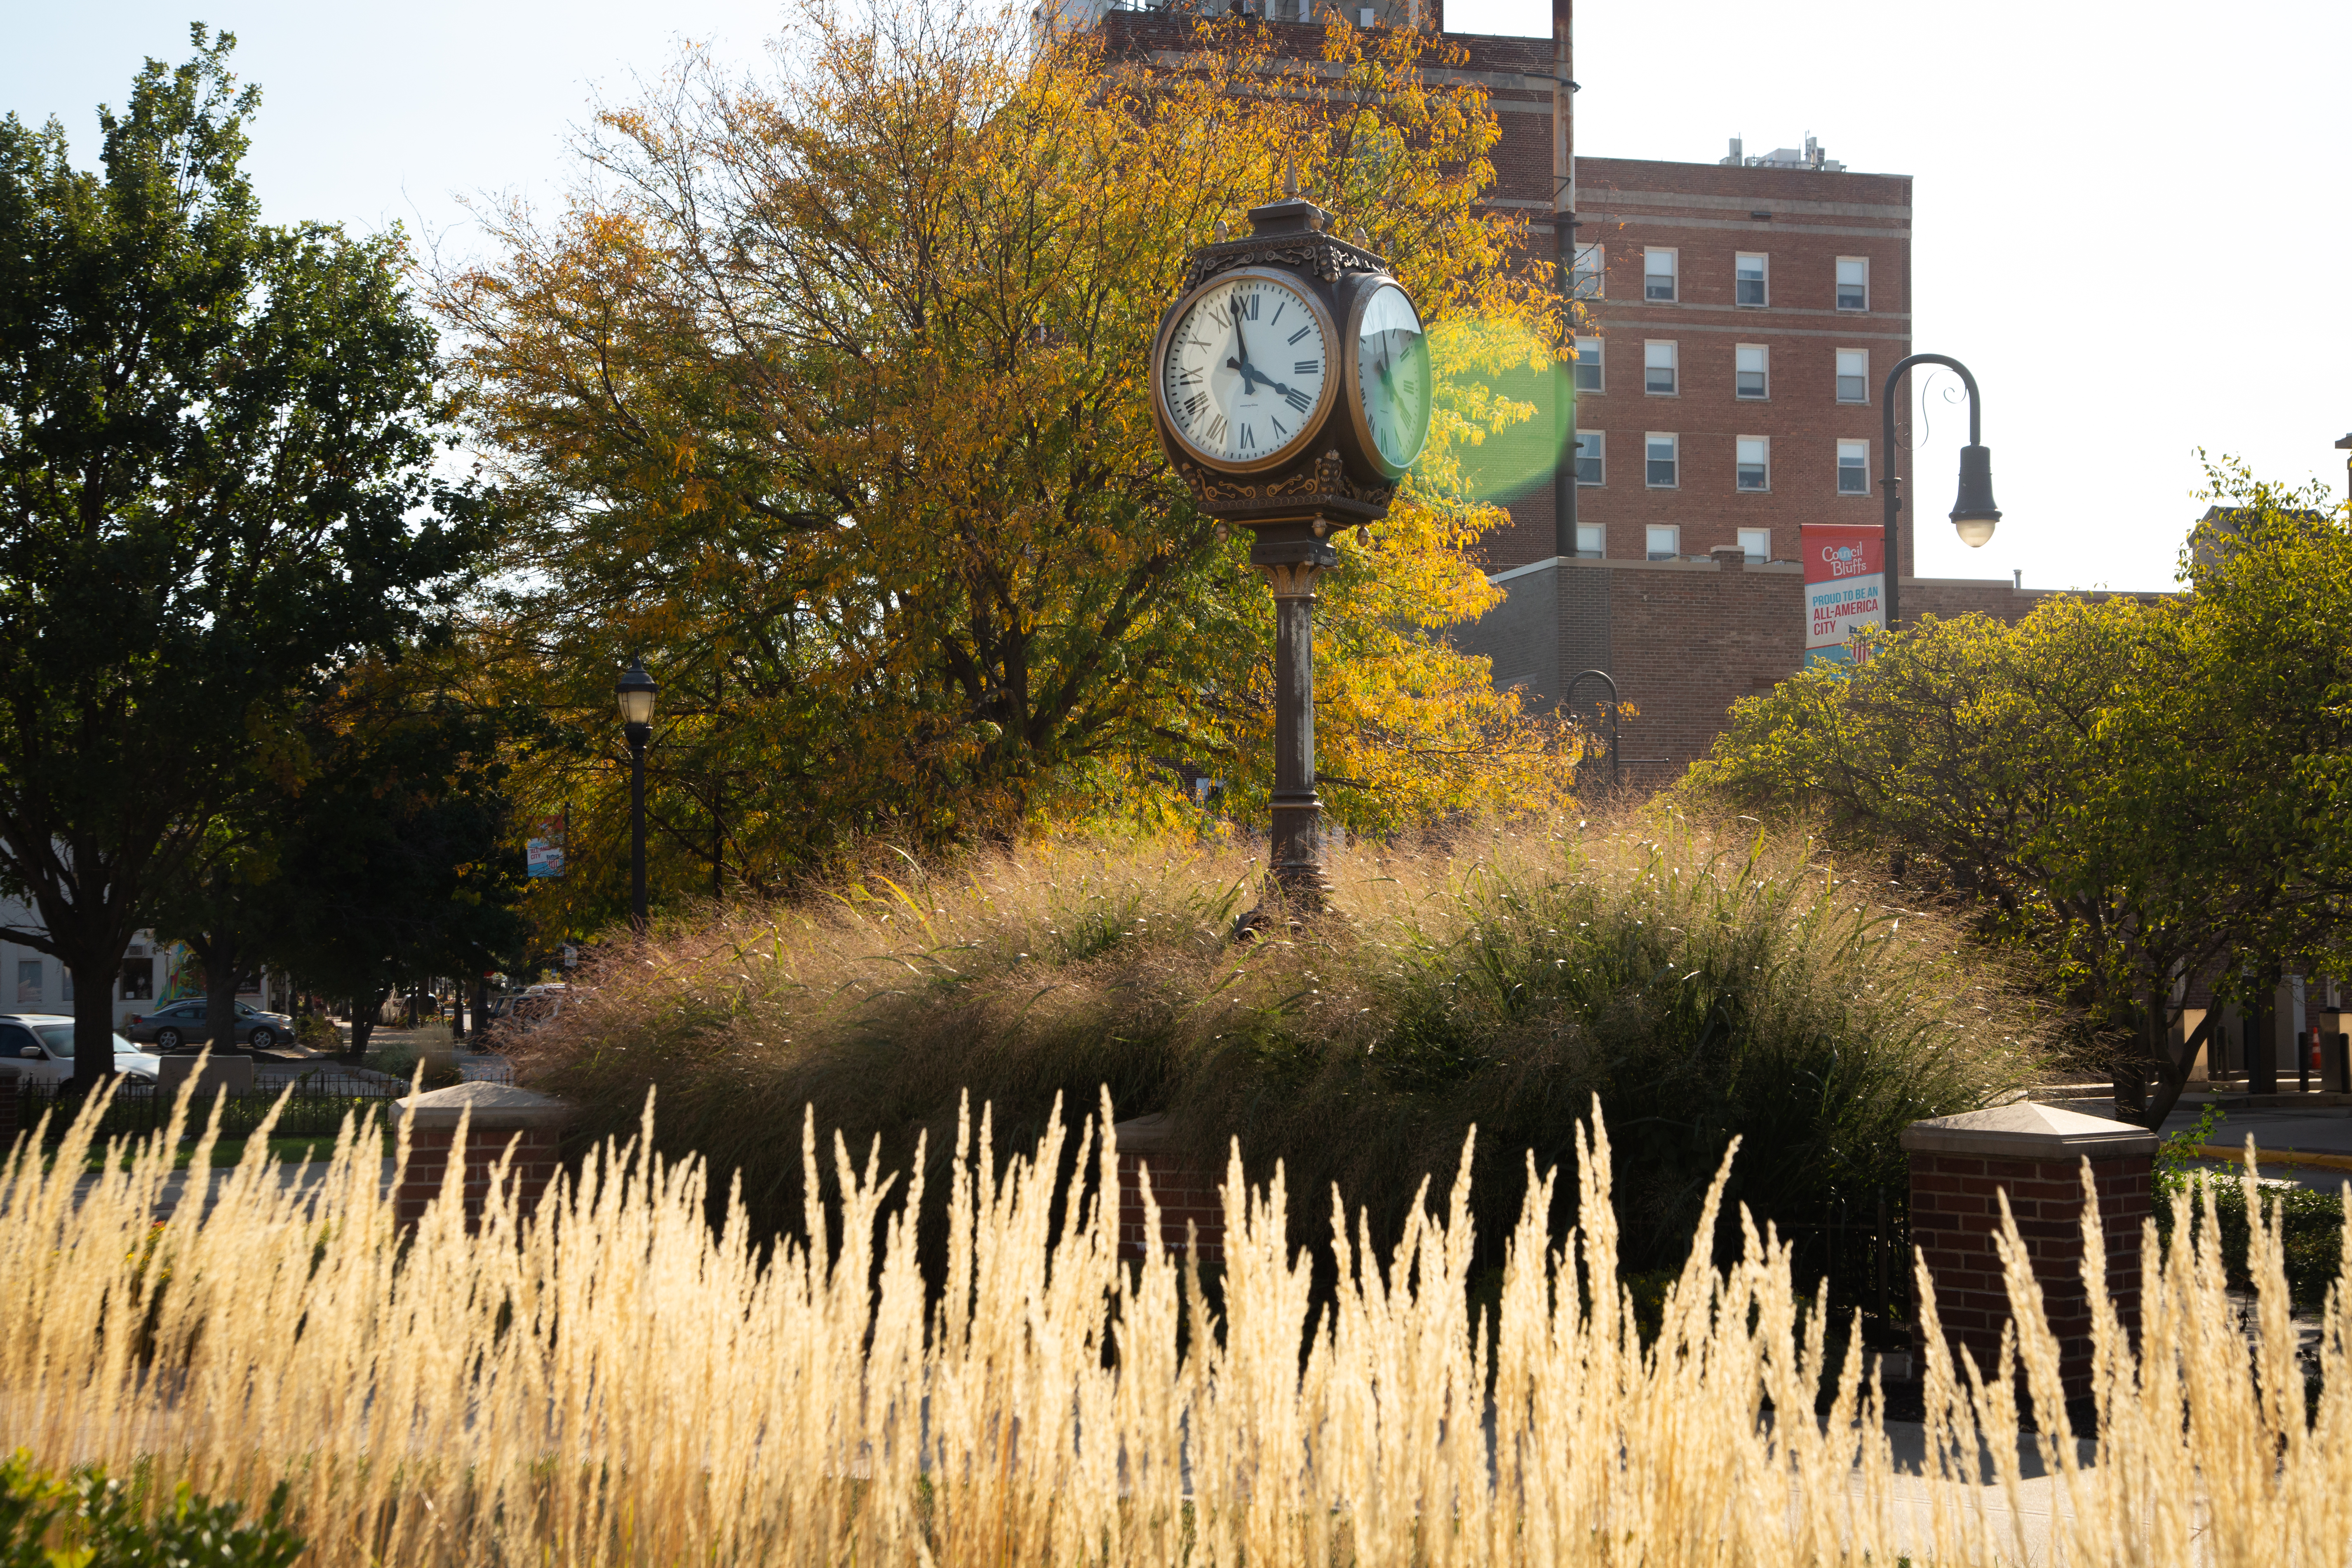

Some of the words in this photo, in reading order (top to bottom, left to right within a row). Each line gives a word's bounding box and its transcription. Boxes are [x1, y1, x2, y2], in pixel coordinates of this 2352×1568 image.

[1239, 294, 1259, 322] XII
[1187, 332, 1212, 354] X
[1294, 360, 1318, 374] III
[1822, 541, 1863, 562] Council
[1830, 557, 1867, 576] Bluffs
[1813, 592, 1841, 607] PROUD
[1842, 590, 1854, 601] TO
[1855, 588, 1866, 599] BE
[1868, 586, 1878, 598] AN
[1814, 599, 1878, 621] ALL-AMERICA
[1814, 620, 1836, 636] CITY
